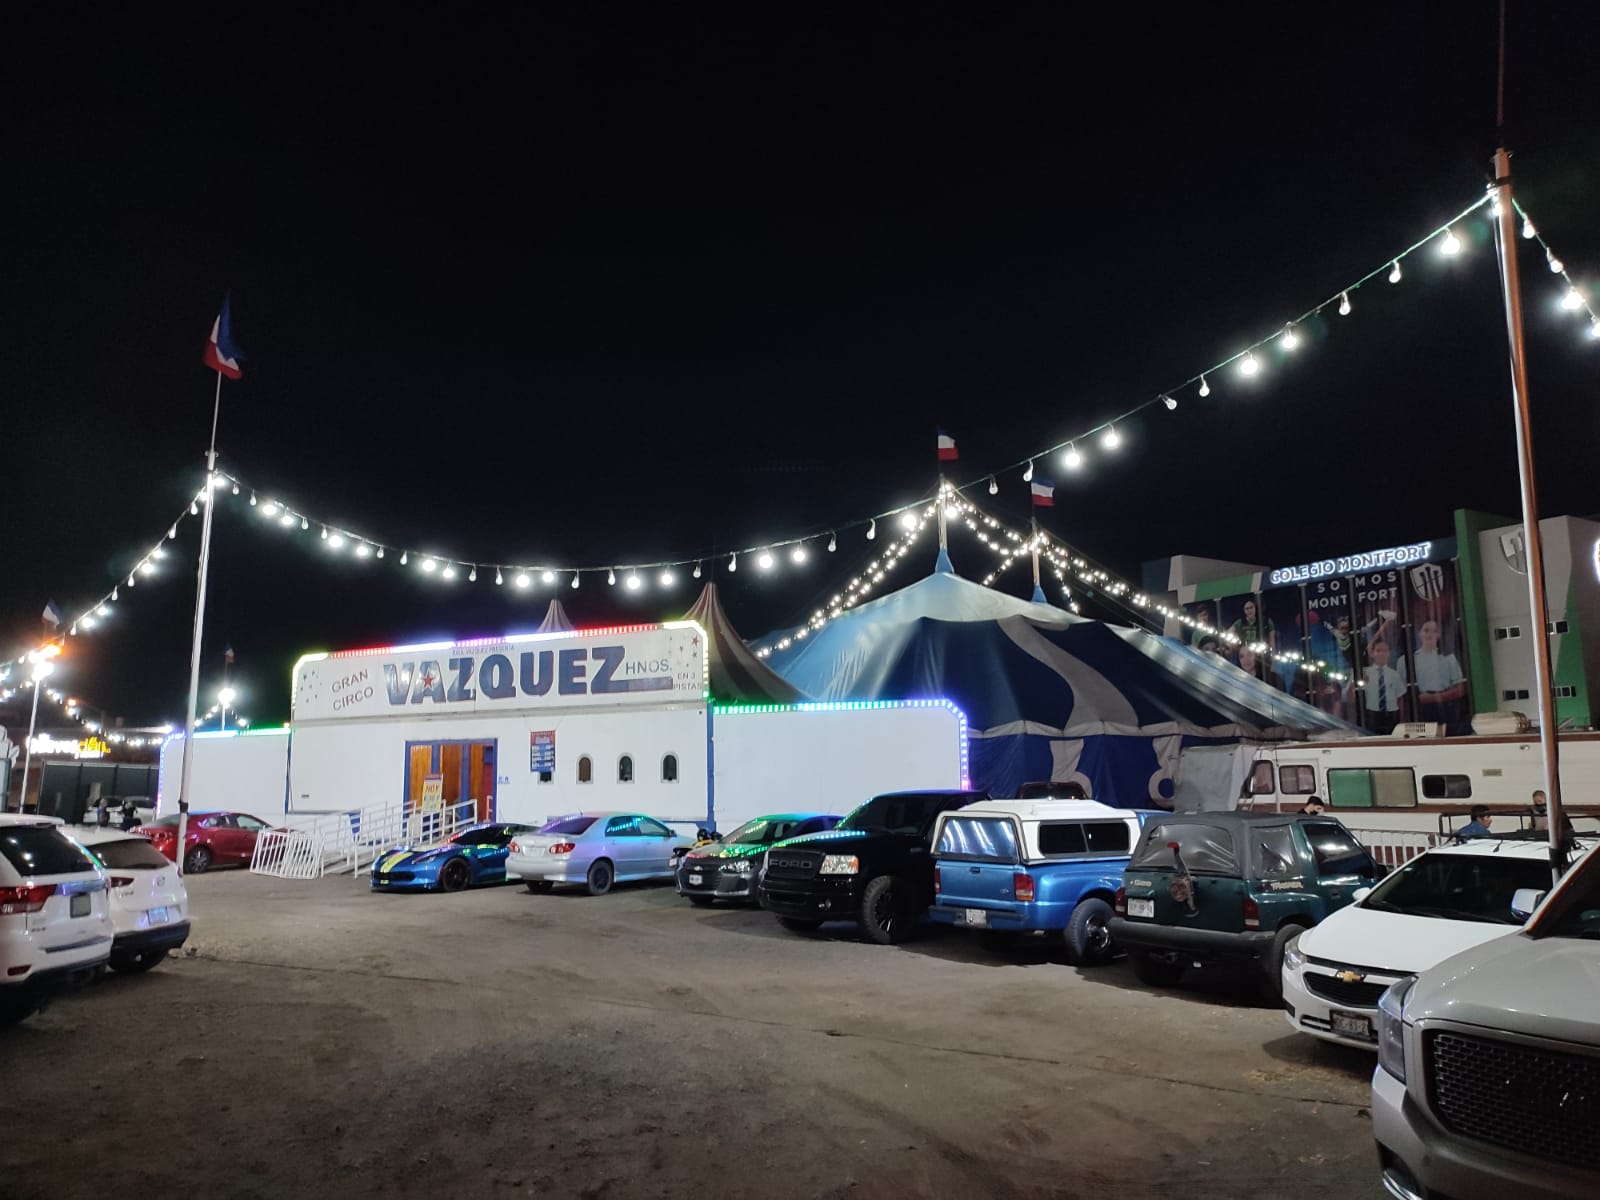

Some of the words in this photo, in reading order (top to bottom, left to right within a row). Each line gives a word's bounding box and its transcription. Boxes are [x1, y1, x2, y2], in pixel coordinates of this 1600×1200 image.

[1270, 559, 1335, 584] COLEGIO
[1337, 541, 1432, 573] MONTFORT
[331, 668, 368, 693] GRAN
[383, 645, 673, 706] VAZQUEZ
[333, 686, 374, 711] CIRCO
[769, 859, 812, 868] FORD
